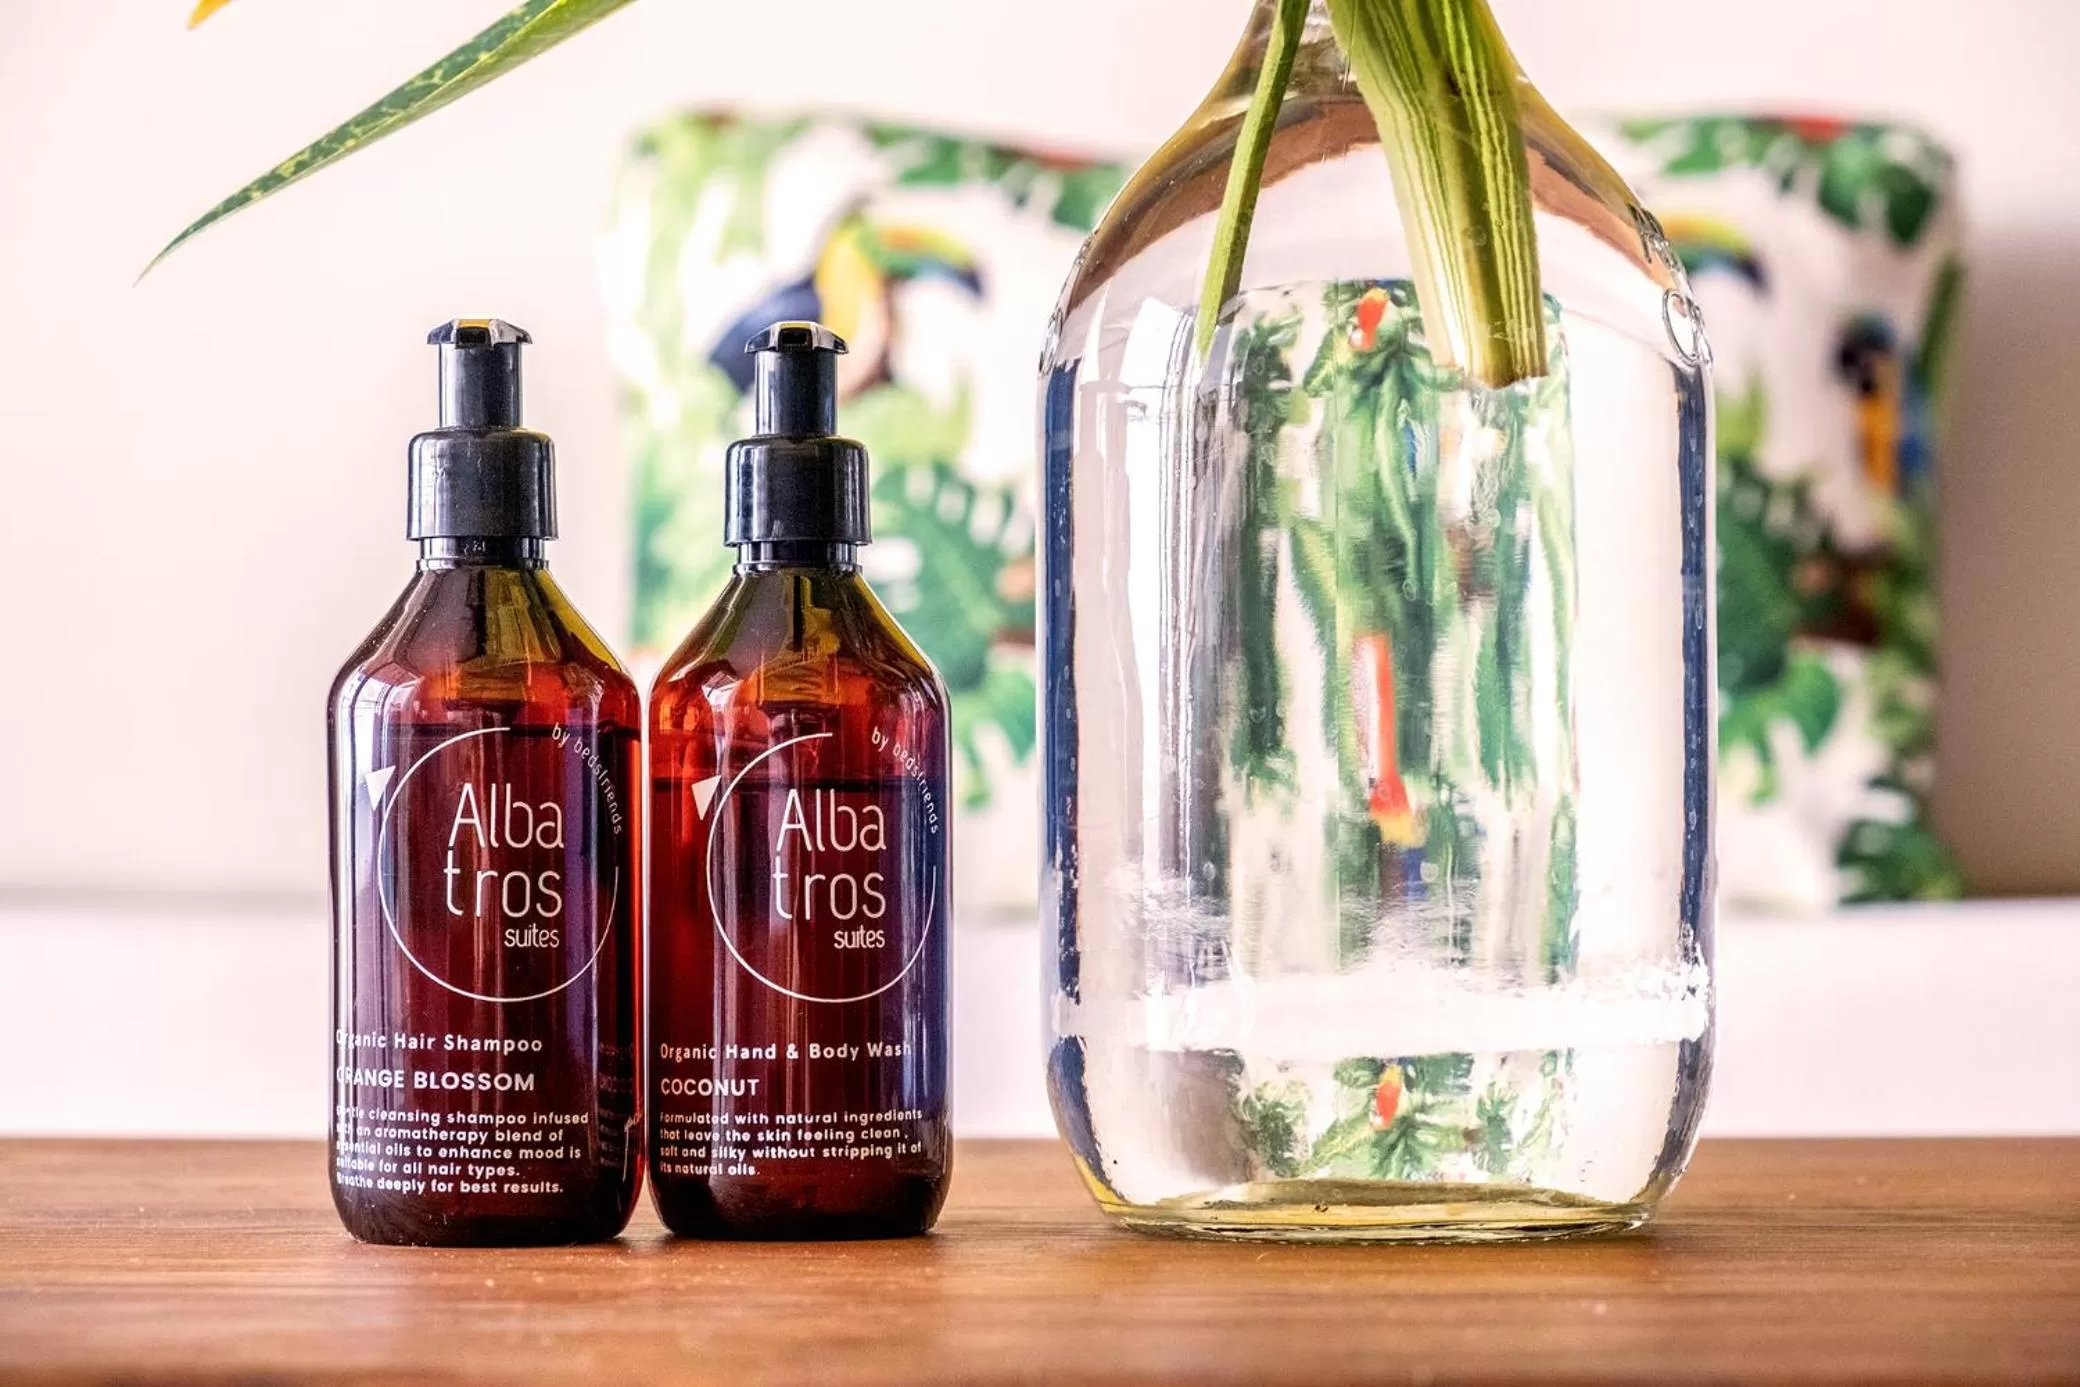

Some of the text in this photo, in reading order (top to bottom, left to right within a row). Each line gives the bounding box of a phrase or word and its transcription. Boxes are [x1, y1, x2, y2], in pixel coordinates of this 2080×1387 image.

[552, 722, 570, 748] by
[872, 726, 889, 752] by
[449, 782, 564, 849] Alba
[777, 788, 887, 852] Alba
[443, 850, 563, 918] tros
[773, 855, 886, 921] tros
[504, 922, 560, 949] suites
[834, 925, 885, 949] suites
[394, 1032, 436, 1050] Hair
[443, 1034, 542, 1055] Shampoo
[660, 1042, 912, 1062] Organic Hand & Body Wash
[414, 1071, 535, 1091] BLOSSOM
[660, 1079, 759, 1096] COCONUT
[368, 1107, 441, 1127] cleansing
[447, 1111, 527, 1127] shampoo
[533, 1112, 589, 1125] infused
[735, 1112, 770, 1125] with
[775, 1111, 838, 1124] natural
[844, 1109, 923, 1126] ingredients
[356, 1126, 371, 1137] an
[374, 1127, 489, 1145] aromatherapy
[495, 1130, 542, 1142] blend
[548, 1129, 564, 1142] of
[660, 1128, 681, 1141] that
[684, 1129, 720, 1142] leave
[725, 1129, 751, 1142] the
[757, 1129, 791, 1142] skin
[797, 1128, 855, 1143] feeling
[385, 1143, 411, 1156] oils
[416, 1145, 433, 1157] to
[438, 1146, 513, 1159] enhance
[519, 1146, 564, 1159] mood
[569, 1146, 582, 1159] is
[681, 1146, 706, 1158] and
[711, 1146, 746, 1162] silky
[752, 1145, 815, 1158] without
[822, 1144, 893, 1160] stripping
[897, 1142, 907, 1154] it
[910, 1141, 922, 1153] of
[379, 1159, 398, 1174] for
[403, 1162, 422, 1174] all
[467, 1164, 520, 1180] types.
[674, 1162, 723, 1176] natural
[727, 1162, 761, 1176] oils.
[376, 1177, 425, 1195] deeply
[431, 1179, 454, 1193] for
[460, 1181, 497, 1194] best
[503, 1181, 564, 1194] results.
